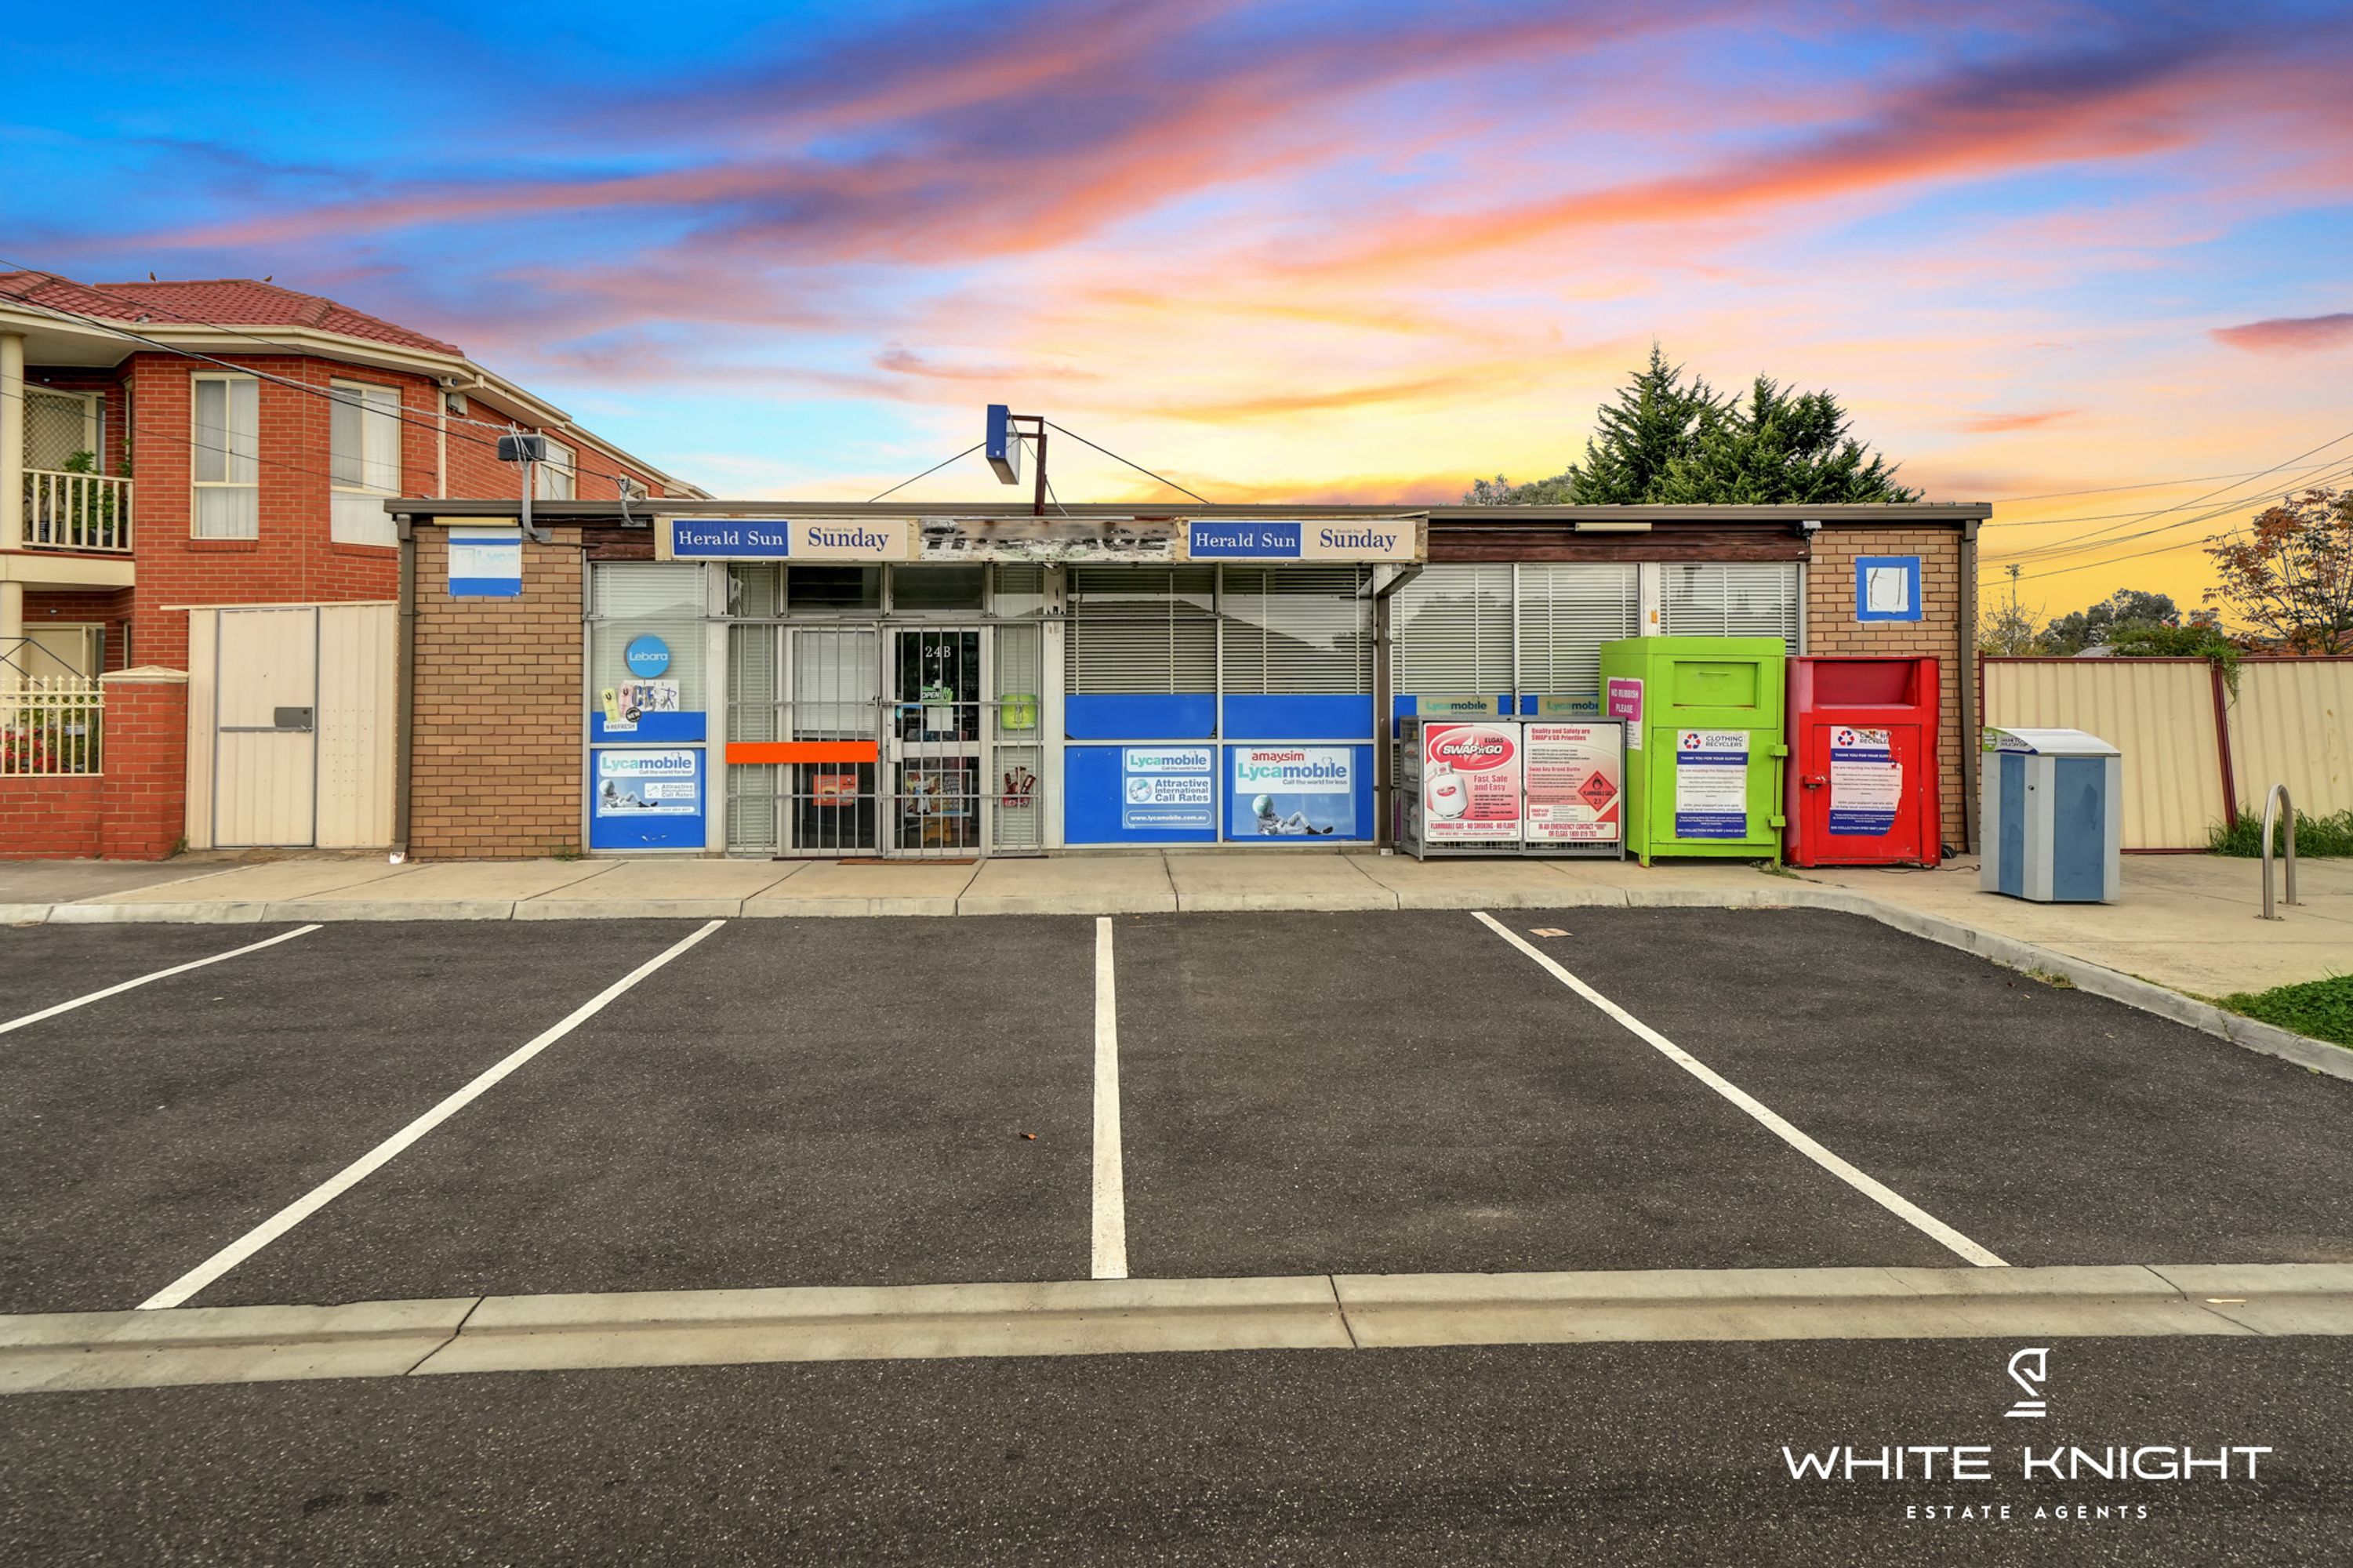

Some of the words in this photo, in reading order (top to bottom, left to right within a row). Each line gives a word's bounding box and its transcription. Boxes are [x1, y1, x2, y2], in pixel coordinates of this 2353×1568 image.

[679, 531, 739, 546] Herald
[747, 531, 783, 546] Sun
[808, 527, 889, 552] Sunday
[1195, 533, 1253, 547] Herald
[1262, 533, 1295, 548] Sun
[1320, 528, 1397, 552] Sunday
[629, 652, 668, 661] Lebara
[925, 646, 951, 657] 24B
[1610, 688, 1618, 697] NO
[1618, 688, 1639, 699] RUBBISH
[1425, 701, 1487, 712] Lycamobile
[1547, 701, 1599, 711] Lycamobi
[1615, 703, 1633, 713] PLEASE
[1130, 754, 1207, 768] Lycamobile
[1251, 750, 1305, 763] amaysim
[602, 757, 692, 771] Lycamobile
[1238, 763, 1347, 781] Lycamobile
